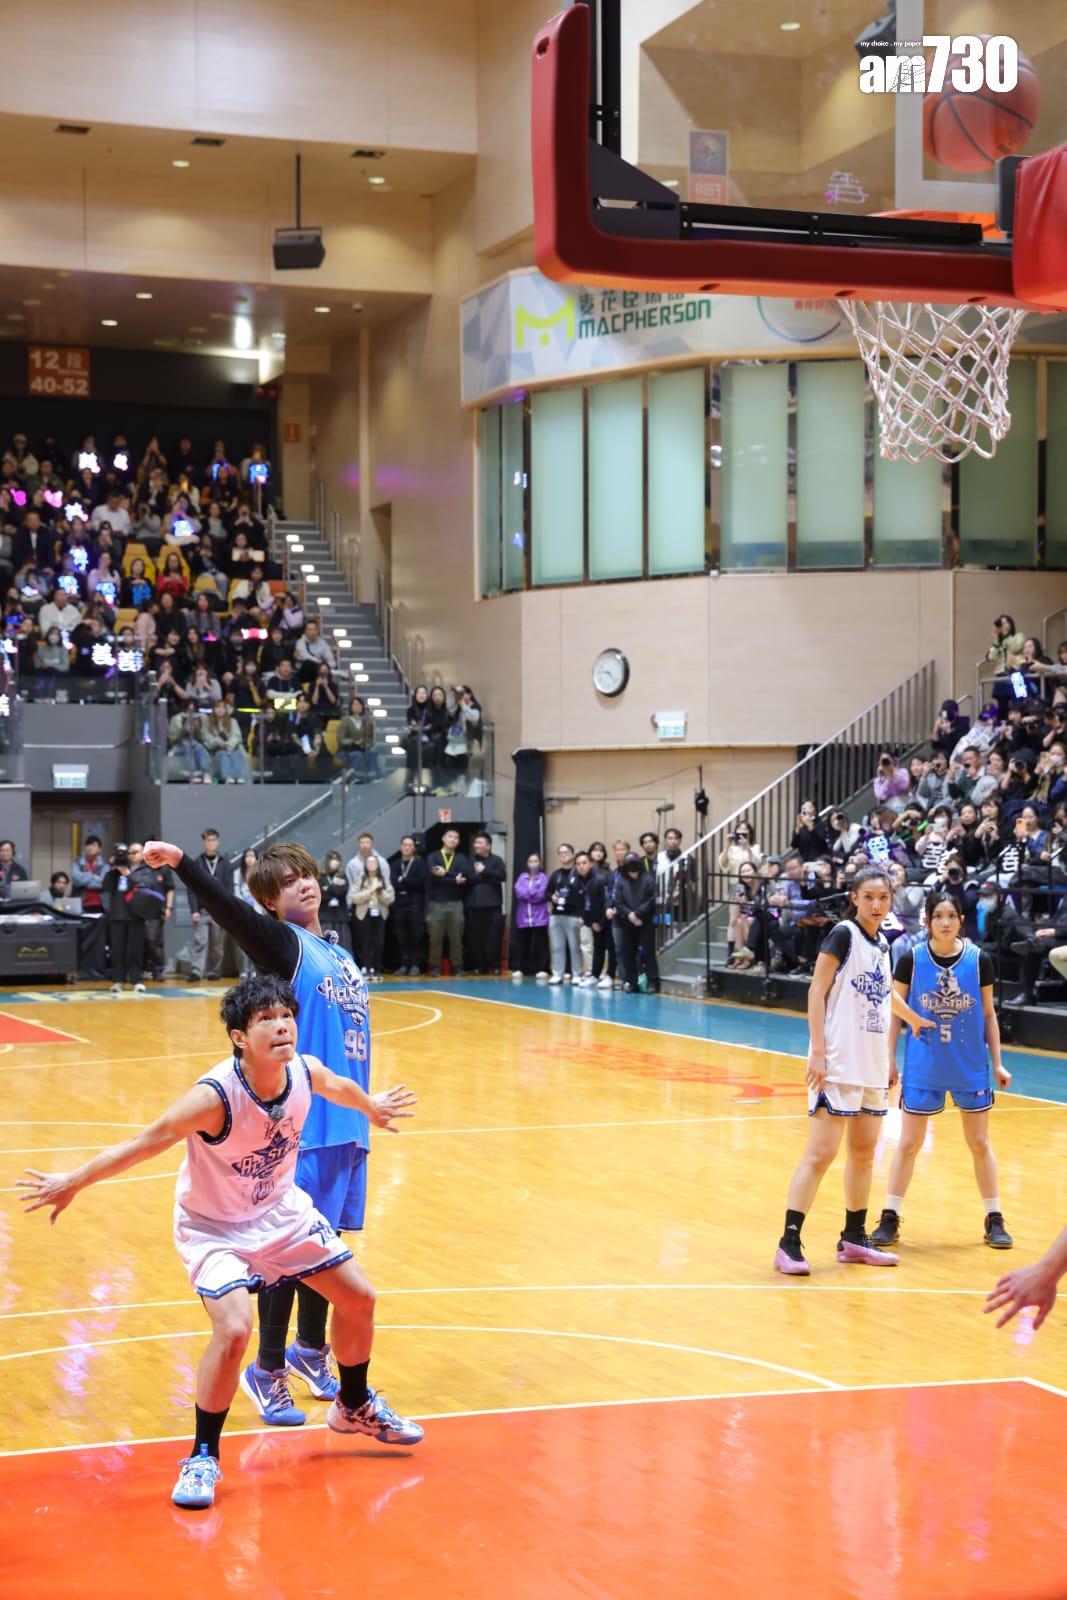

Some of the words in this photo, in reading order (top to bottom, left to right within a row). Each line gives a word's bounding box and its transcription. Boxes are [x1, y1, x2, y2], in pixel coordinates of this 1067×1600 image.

[579, 298, 711, 339] MACPHERSON
[31, 350, 59, 369] 12
[31, 376, 88, 395] 40-52
[940, 1024, 952, 1043] 5
